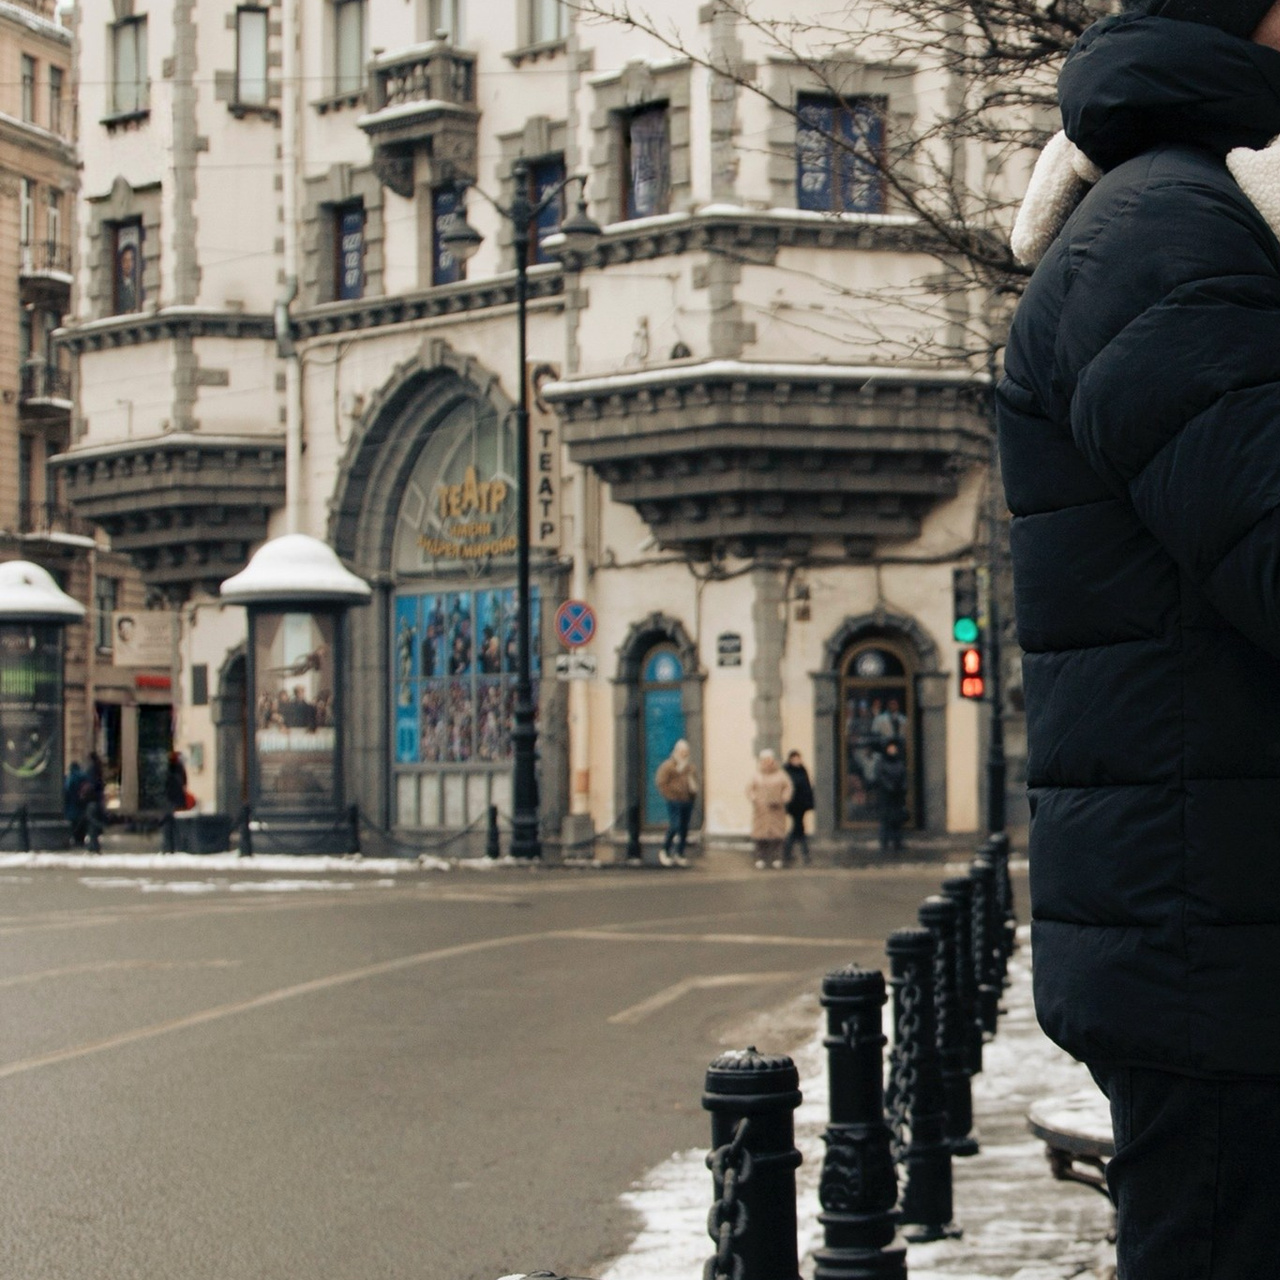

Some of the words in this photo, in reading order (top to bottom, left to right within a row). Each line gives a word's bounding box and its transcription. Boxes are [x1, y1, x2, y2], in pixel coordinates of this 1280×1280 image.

[436, 466, 507, 519] ТЕАТР
[538, 428, 554, 541] ТЕАТР
[460, 534, 518, 559] МИРОНО
